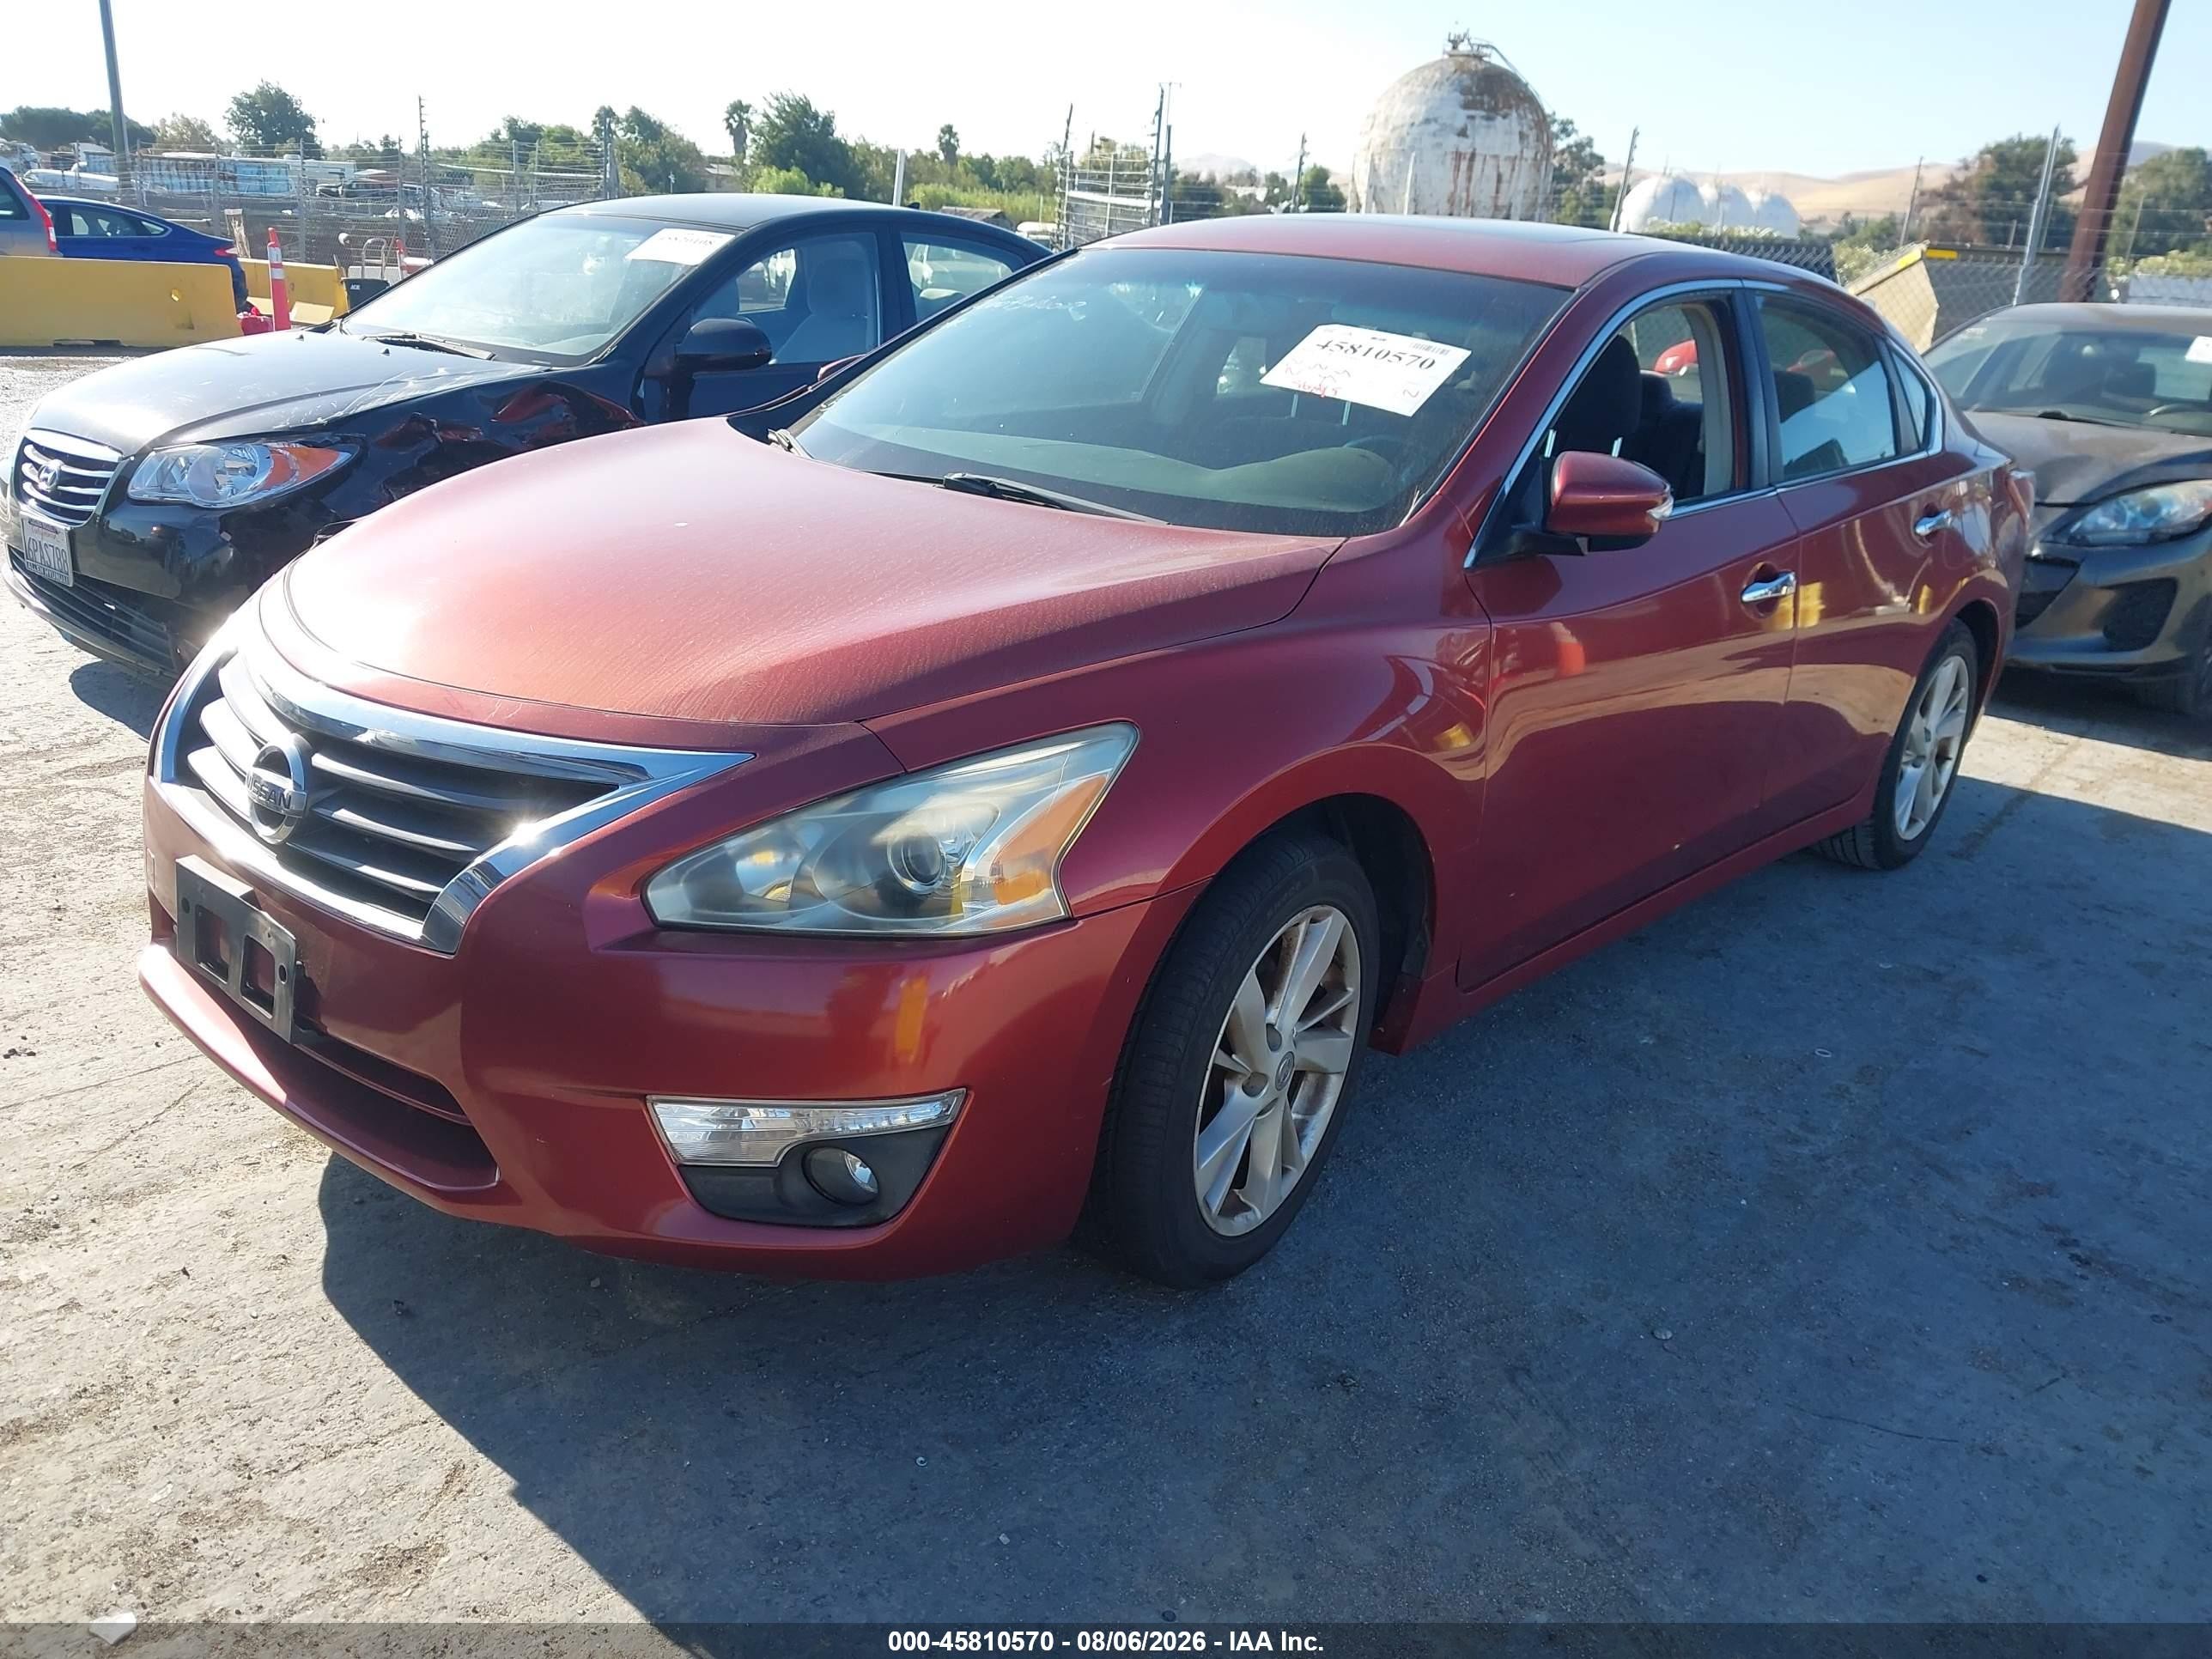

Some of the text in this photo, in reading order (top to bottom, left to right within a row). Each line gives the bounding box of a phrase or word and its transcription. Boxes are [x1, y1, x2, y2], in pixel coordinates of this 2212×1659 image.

[1316, 340, 1436, 369] 45810570
[27, 537, 69, 573] 6PAS788
[246, 774, 293, 810] NISSAN
